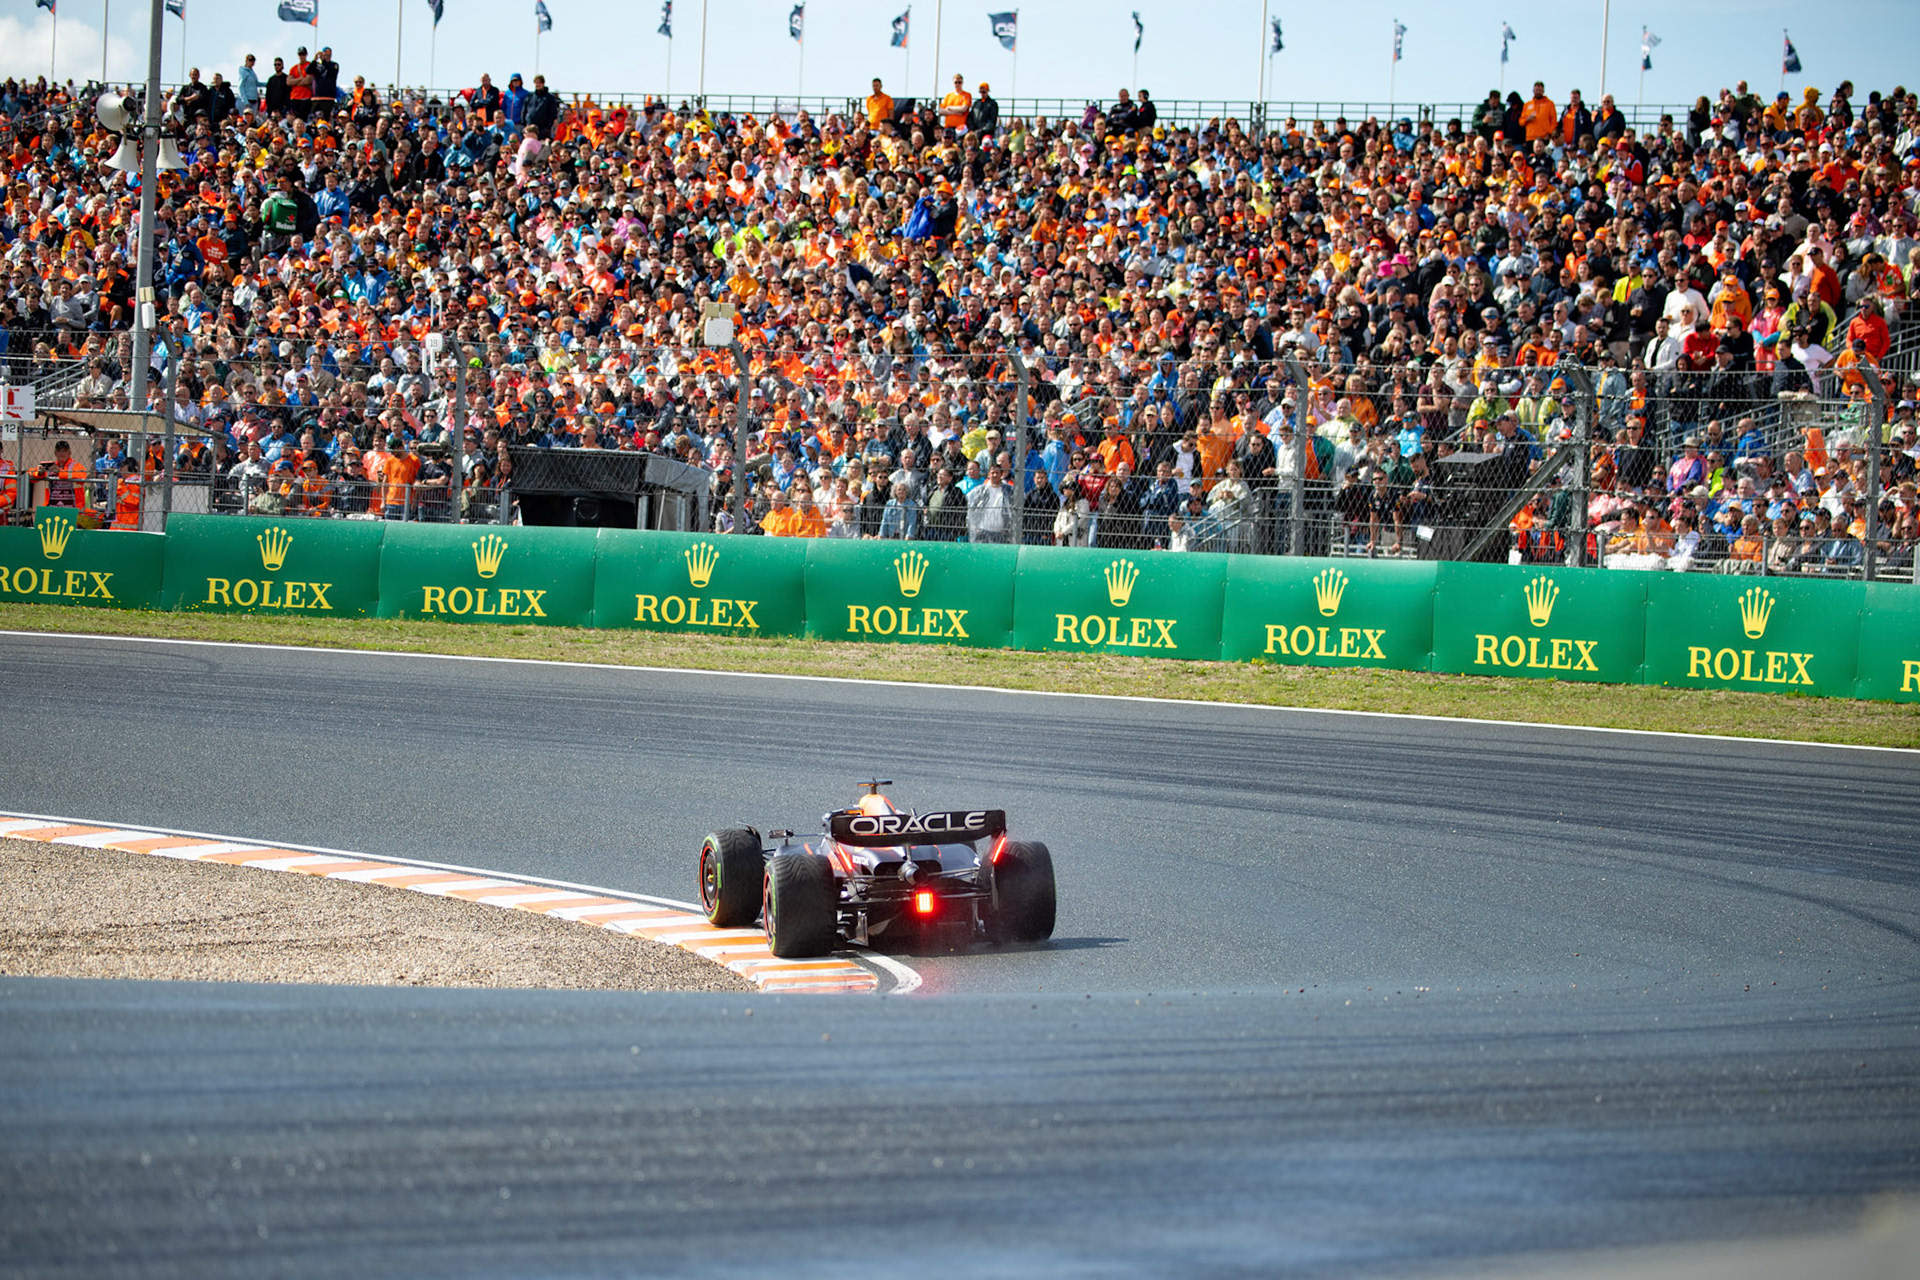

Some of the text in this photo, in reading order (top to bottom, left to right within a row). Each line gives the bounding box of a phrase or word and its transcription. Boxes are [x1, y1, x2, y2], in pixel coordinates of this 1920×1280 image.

[4, 423, 16, 433] 12
[206, 578, 332, 610] ROLEX
[420, 586, 547, 617] ROLEX
[633, 594, 760, 629] ROLEX
[847, 604, 970, 638] ROLEX
[1055, 614, 1178, 648] ROLEX
[1264, 624, 1387, 659] ROLEX
[1475, 635, 1599, 671] ROLEX
[1687, 646, 1815, 685] ROLEX
[849, 811, 986, 835] ORACLE
